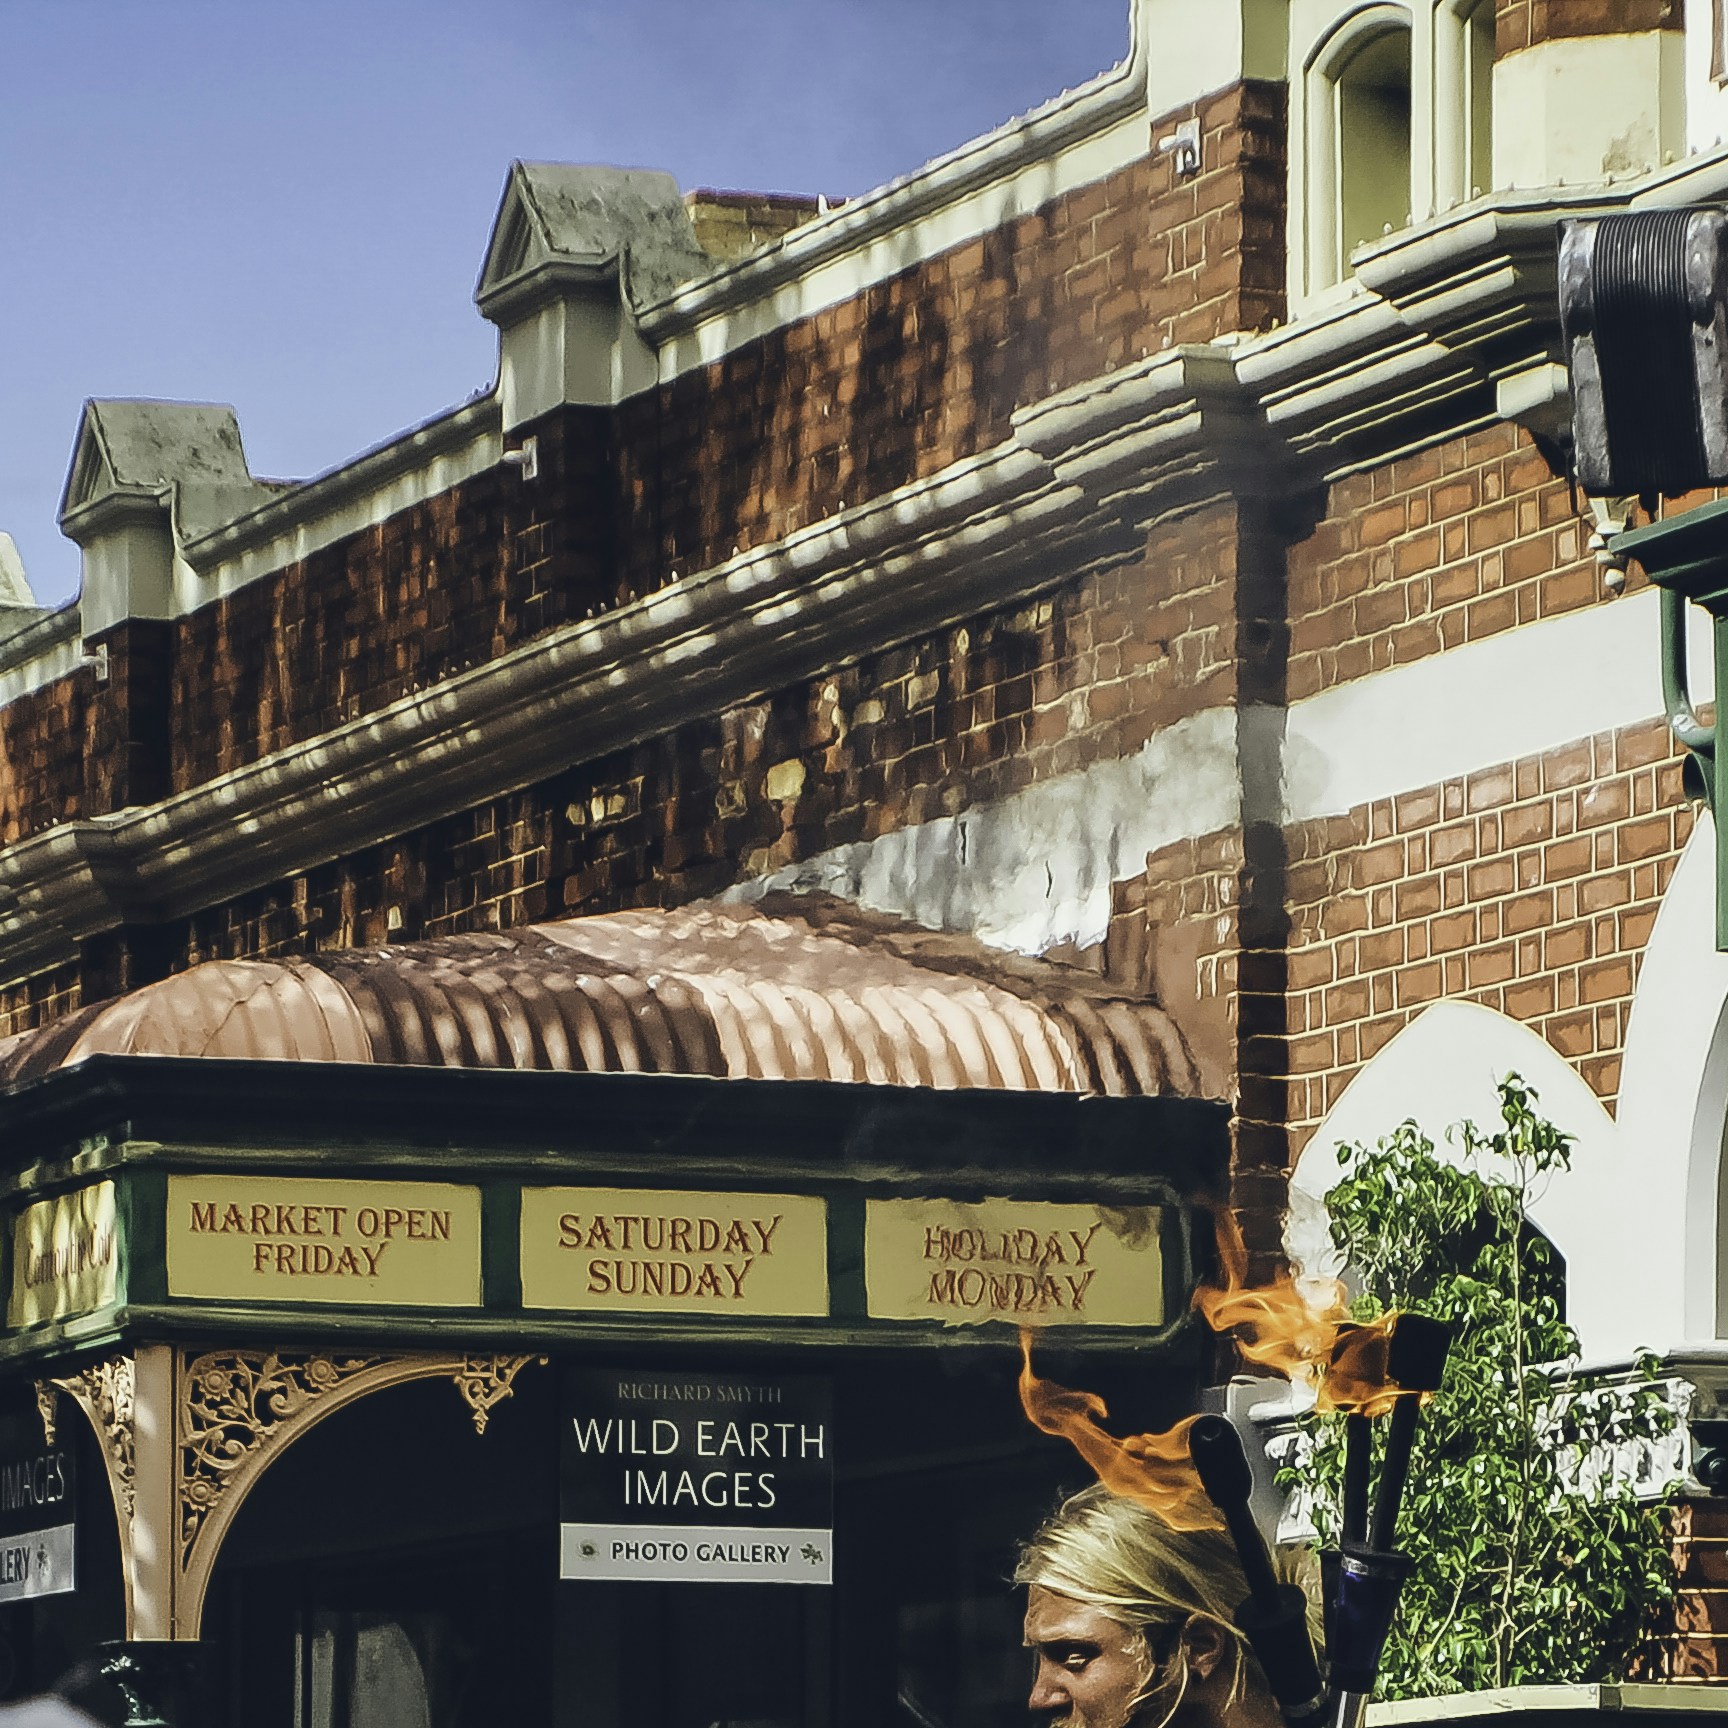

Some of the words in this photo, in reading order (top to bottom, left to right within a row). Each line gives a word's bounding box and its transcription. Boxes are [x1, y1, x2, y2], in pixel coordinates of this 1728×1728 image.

[189, 1201, 348, 1237] MARKET
[356, 1207, 452, 1240] OPEN
[558, 1213, 784, 1255] SATURDAY
[252, 1241, 391, 1277] FRIDAY
[923, 1221, 1103, 1267] HOLIDAY
[587, 1257, 754, 1298] SUNDAY
[927, 1268, 1097, 1312] MONDAY
[618, 1381, 712, 1402] RICHARD
[716, 1384, 782, 1404] SMYTH
[573, 1417, 680, 1456] WILD
[696, 1420, 824, 1459] EARTH
[1, 1452, 65, 1512] IMAGES
[624, 1470, 776, 1508] IMAGES
[611, 1541, 689, 1563] PHOTO
[696, 1543, 790, 1564] GALLERY
